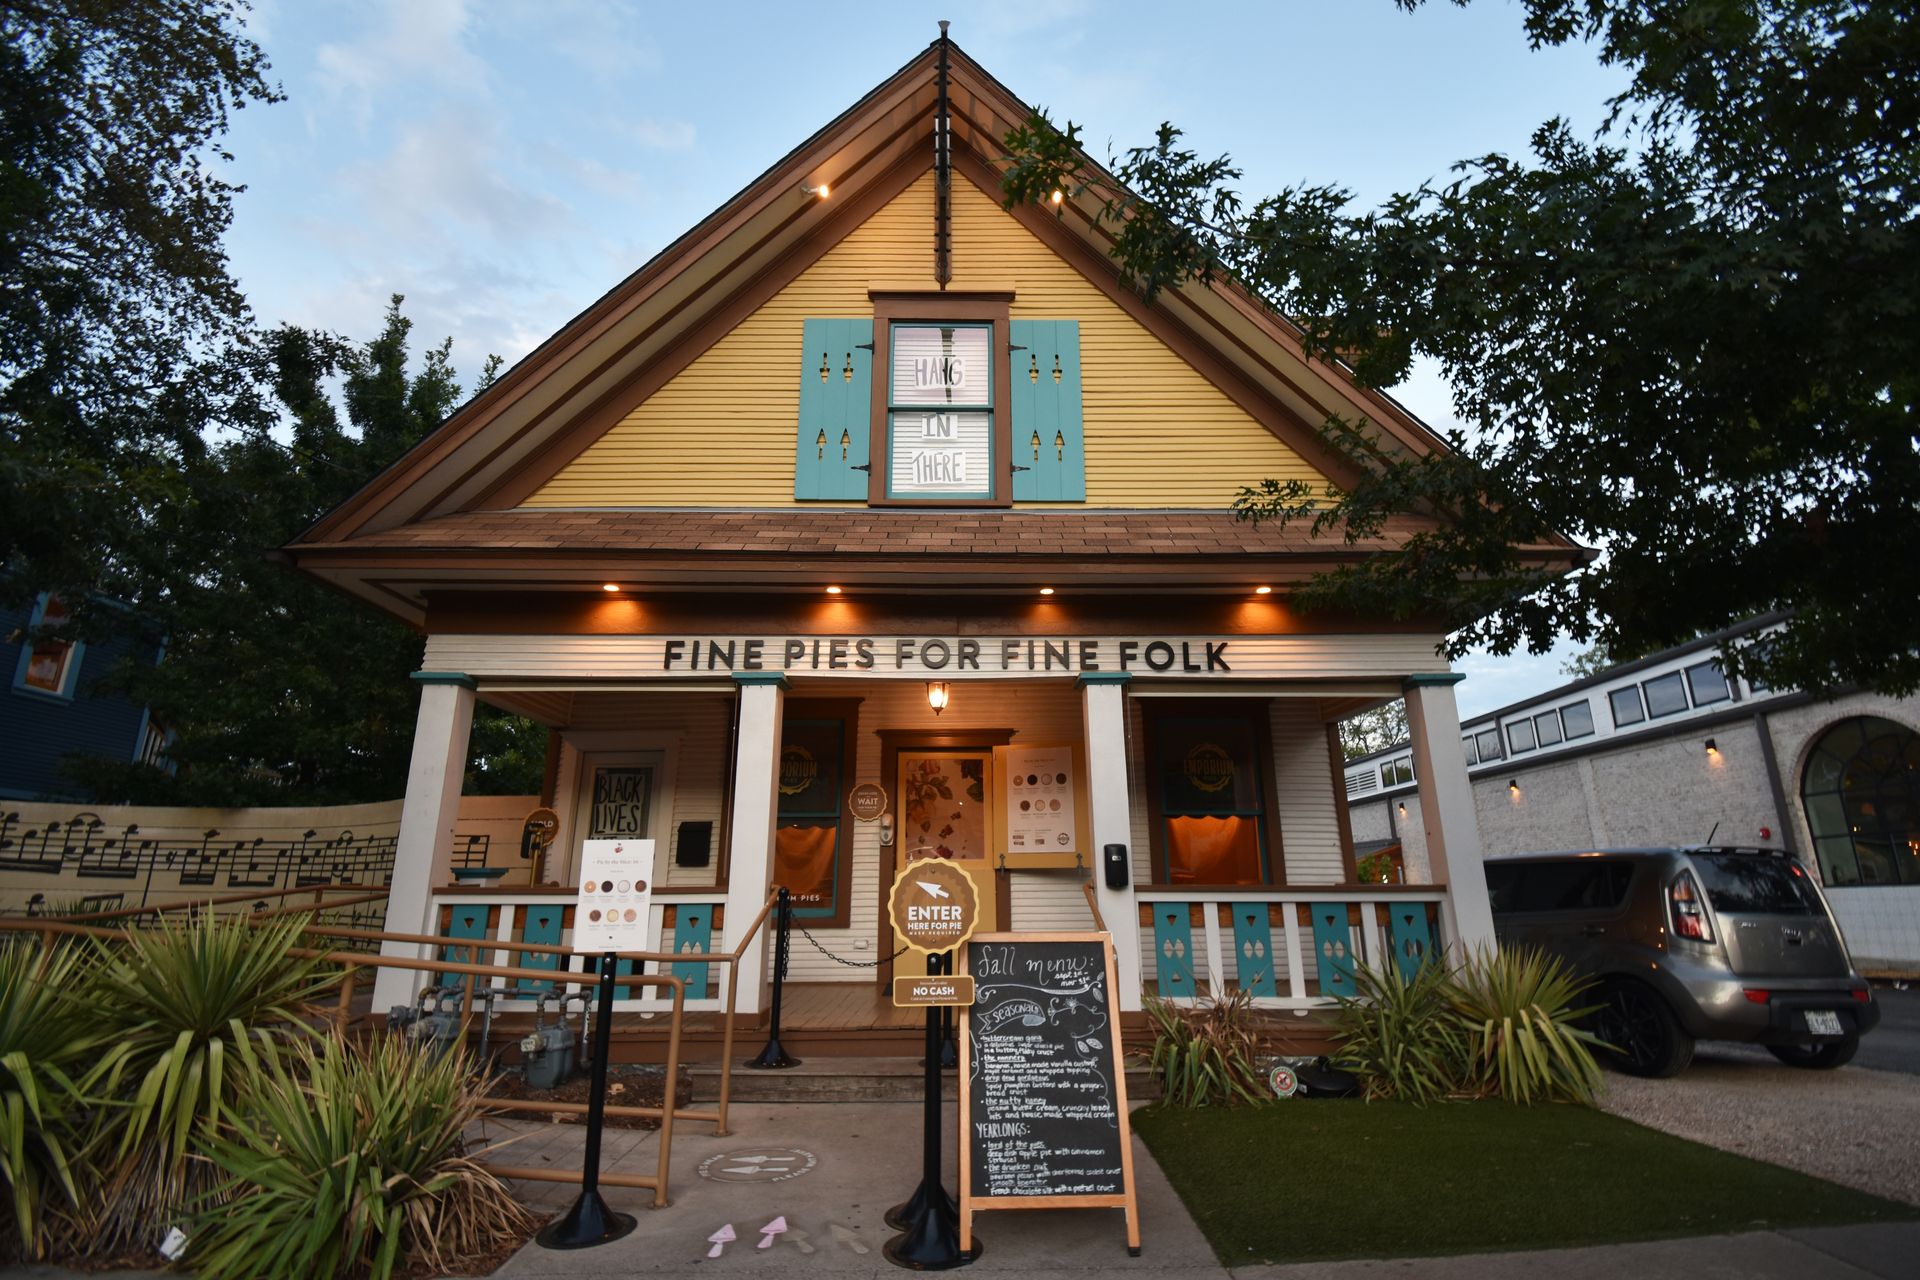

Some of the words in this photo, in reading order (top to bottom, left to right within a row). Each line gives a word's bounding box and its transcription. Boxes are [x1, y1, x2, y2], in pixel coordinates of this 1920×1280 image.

[914, 358, 963, 386] HANG
[923, 414, 950, 437] IN
[912, 452, 963, 484] THERE
[664, 640, 764, 670] FINE
[784, 638, 874, 668] PIES
[896, 638, 980, 669] FOR
[1001, 640, 1099, 670] FINE
[1120, 640, 1231, 671] FOLK
[599, 776, 642, 804] BLACK
[594, 804, 640, 834] LIVES
[908, 906, 962, 920] ENTER
[908, 922, 929, 930] HERE
[978, 945, 1016, 978] fall
[914, 987, 928, 996] NO
[930, 987, 954, 996] CASH
[976, 1122, 1031, 1138] YEARLONGS:
